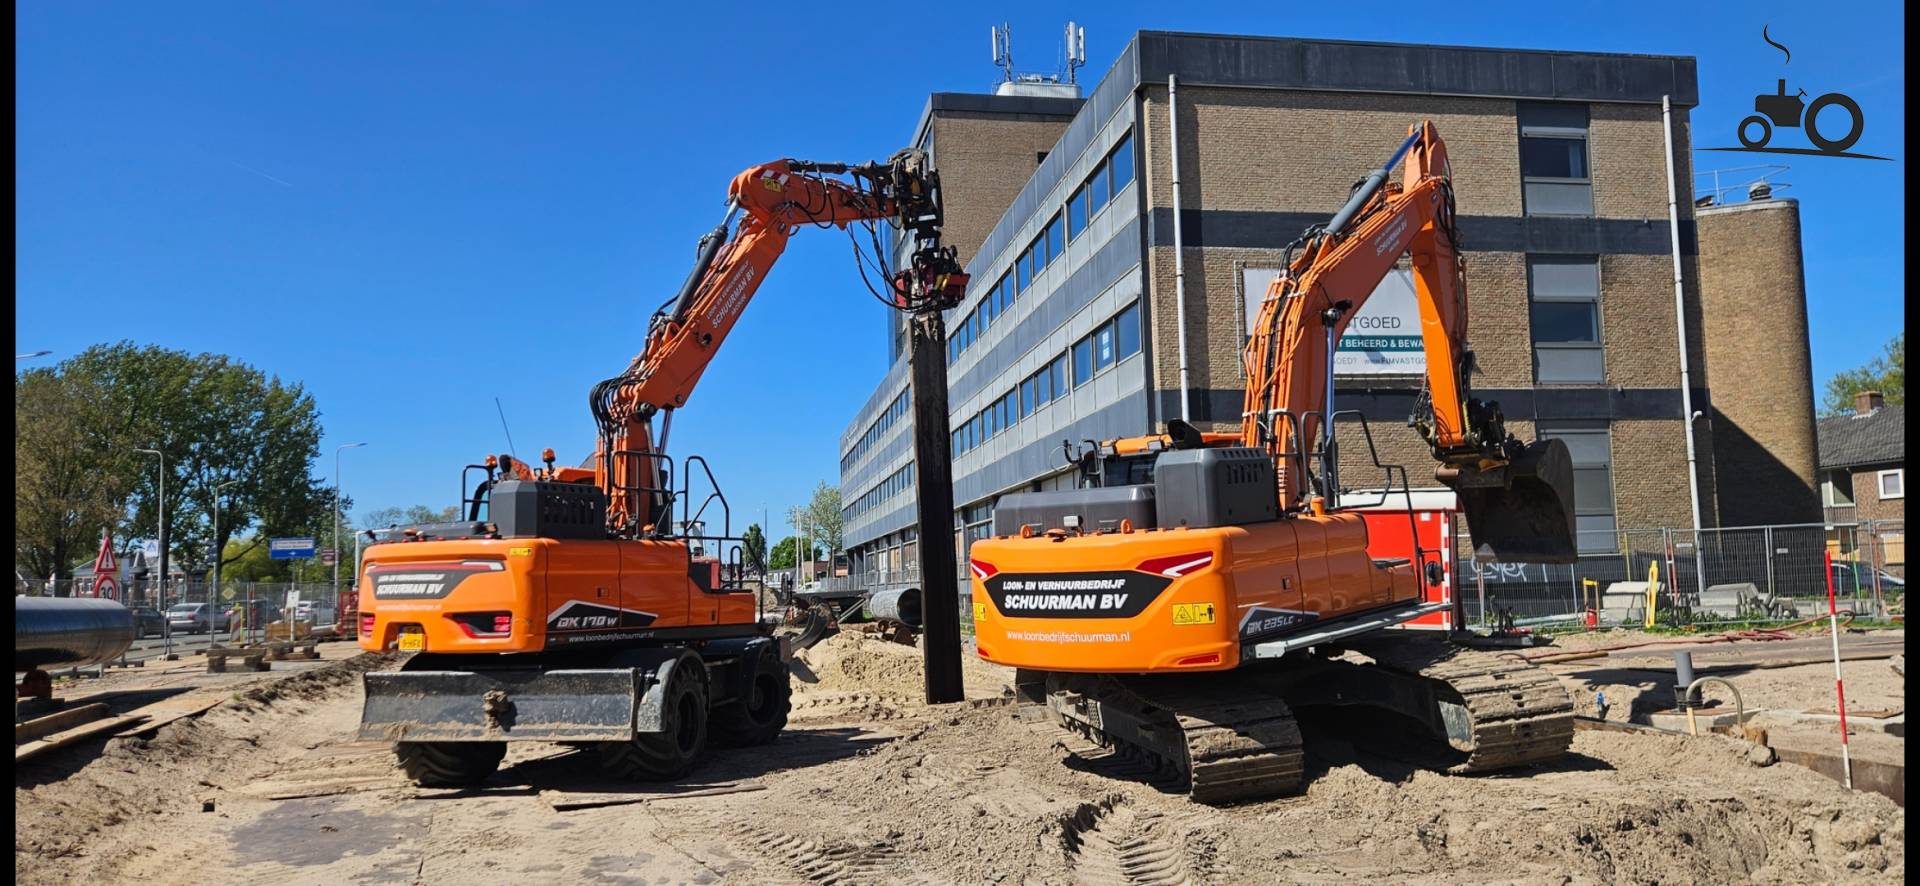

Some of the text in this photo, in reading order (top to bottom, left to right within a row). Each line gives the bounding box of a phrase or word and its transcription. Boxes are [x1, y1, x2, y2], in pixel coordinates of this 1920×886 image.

[712, 277, 749, 329] SCHUURMAN
[746, 265, 756, 283] BV
[1348, 316, 1401, 329] TGOED
[1345, 339, 1388, 348] BEHEERD
[1390, 339, 1397, 348] &
[376, 582, 446, 596] SCHUURMAN BV
[1003, 579, 1126, 591] LOON- EN VERHUURBEDRIJF
[1004, 593, 1129, 610] SCHUURMAN BV
[1006, 631, 1131, 645] www.loonbedrijfschuurman.nl
